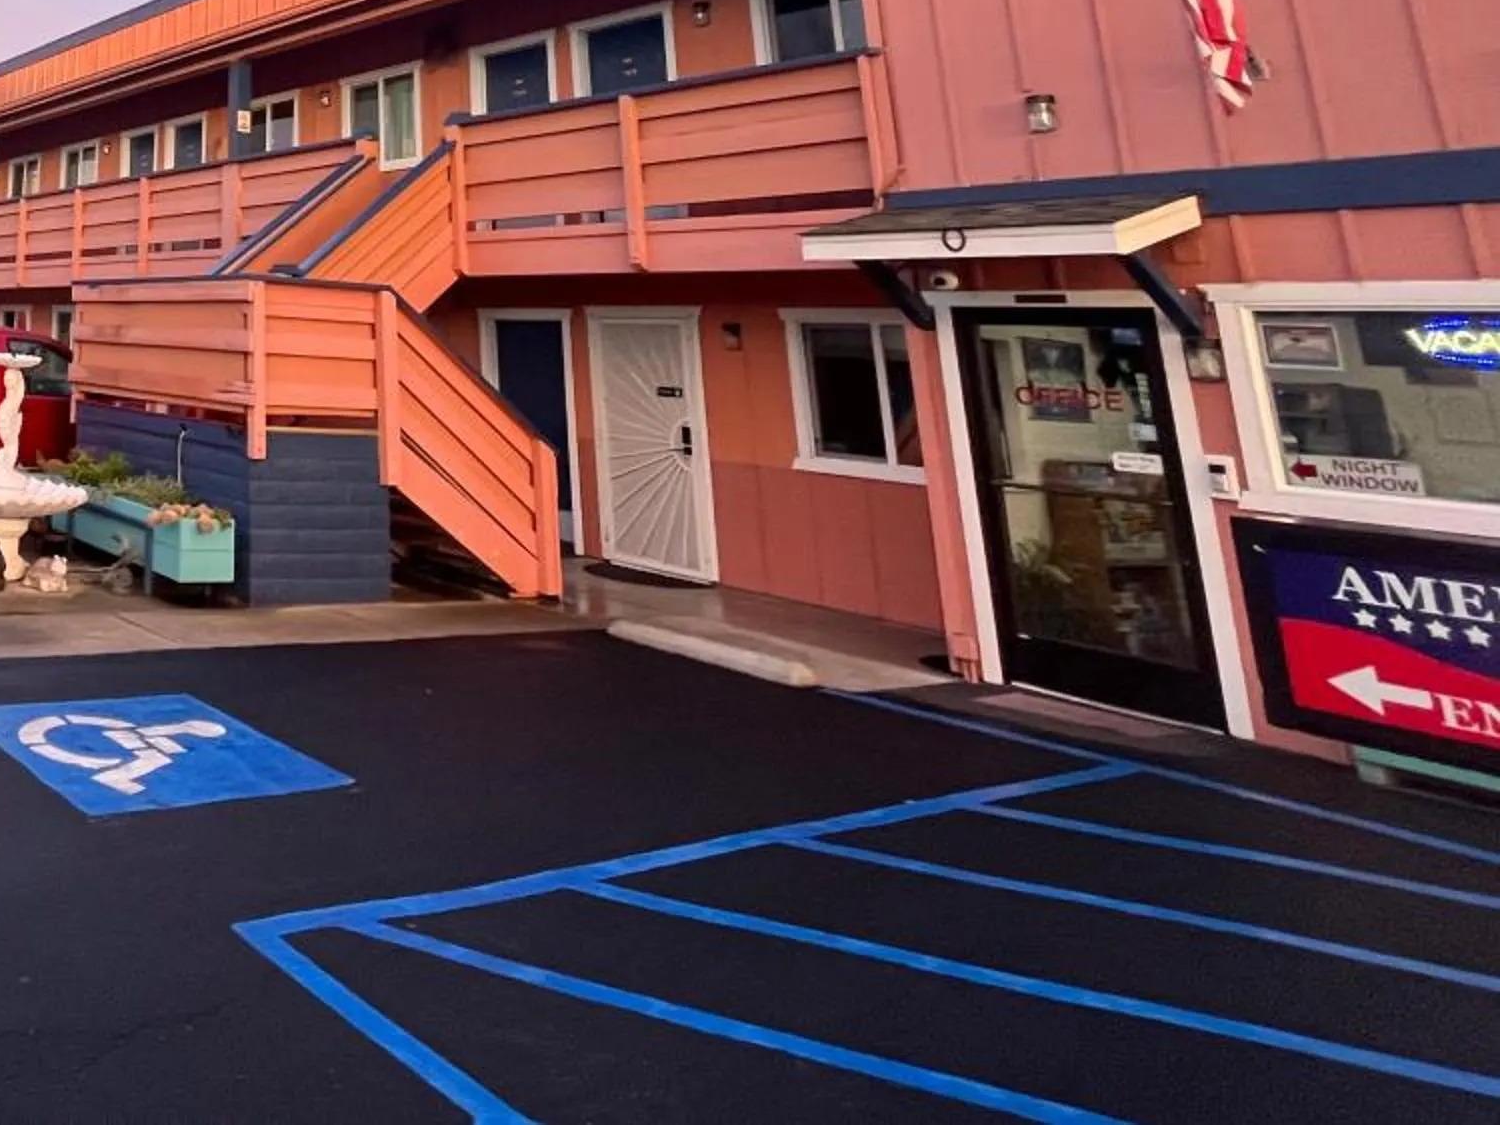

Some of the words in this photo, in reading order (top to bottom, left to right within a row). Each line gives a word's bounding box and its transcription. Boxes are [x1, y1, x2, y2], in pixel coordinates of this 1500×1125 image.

[1331, 459, 1400, 476] NIGHT
[1320, 472, 1419, 493] WINDOW
[1332, 566, 1500, 623] AME
